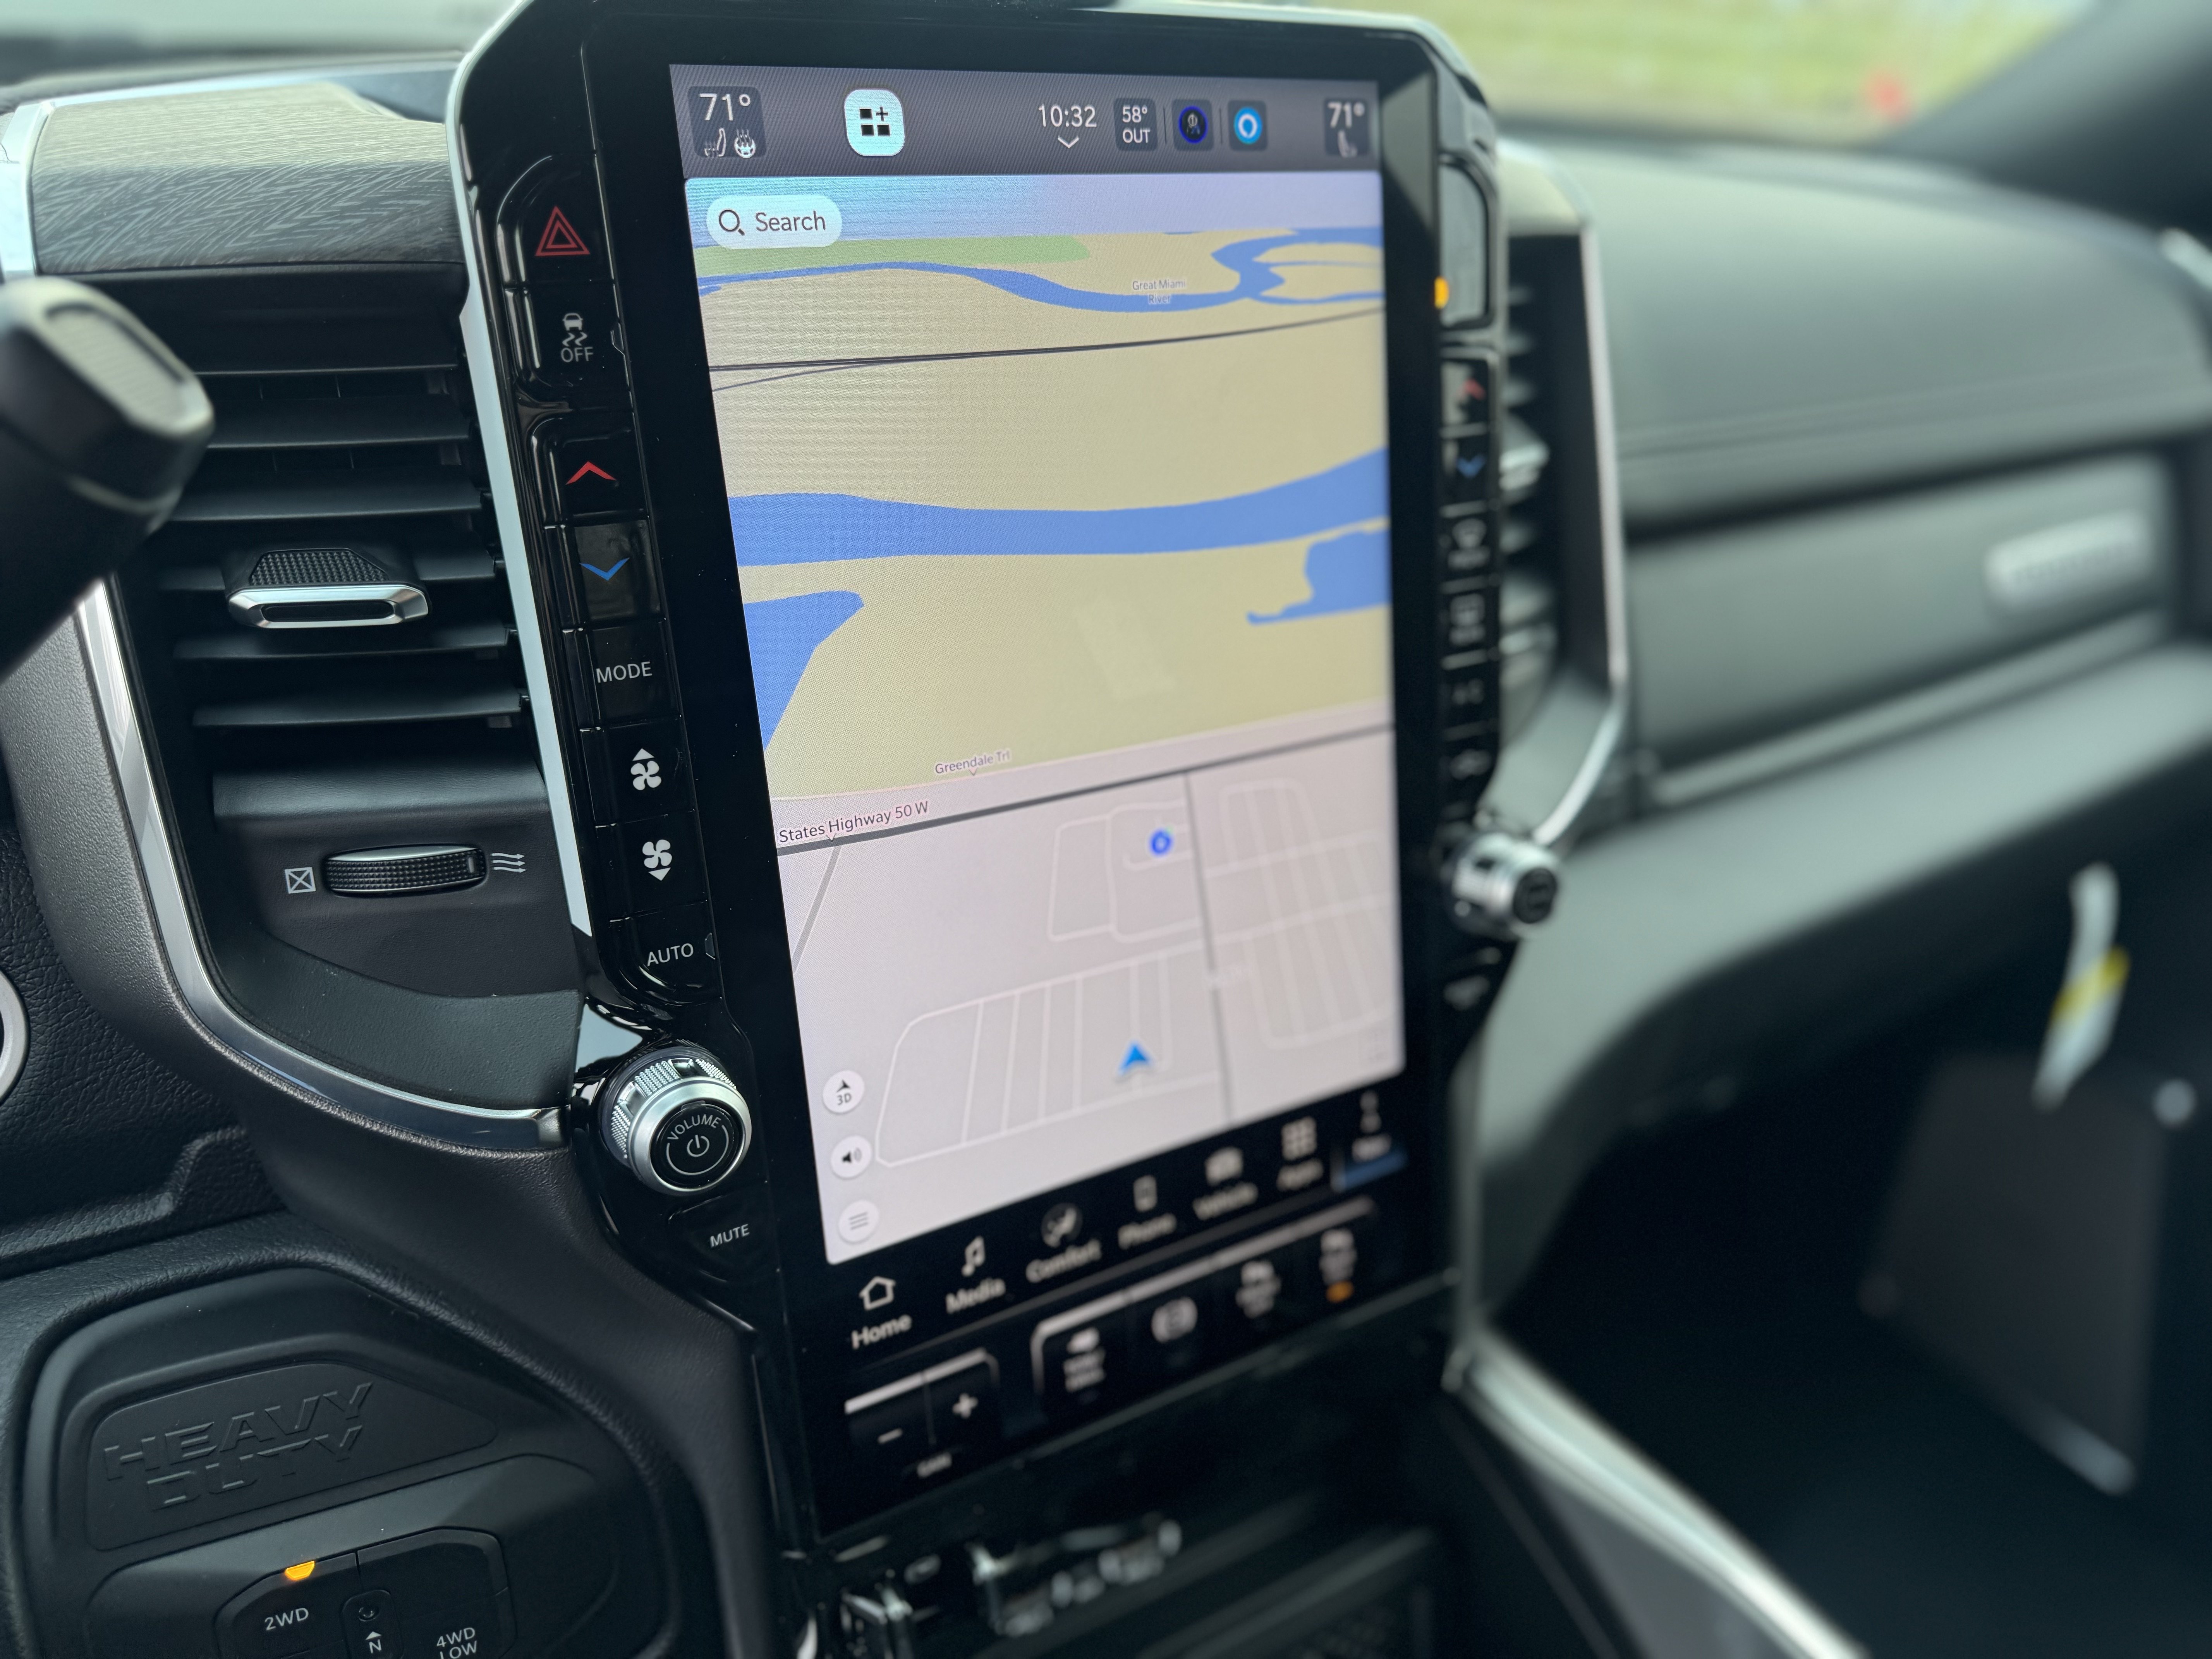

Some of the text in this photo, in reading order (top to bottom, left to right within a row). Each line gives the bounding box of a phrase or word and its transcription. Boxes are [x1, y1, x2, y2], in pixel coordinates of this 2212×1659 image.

[699, 93, 751, 122] 71°
[1039, 104, 1097, 128] 10:32
[1122, 105, 1148, 123] 58°
[1328, 102, 1365, 128] 71°
[1122, 129, 1150, 143] OUT
[755, 210, 826, 232] Search
[1132, 279, 1186, 291] Great Miami
[1148, 293, 1171, 304] River
[560, 347, 593, 362] OFF
[596, 661, 653, 684] MODE
[935, 753, 994, 774] Greendale
[779, 800, 929, 843] States Highway 50 W
[646, 943, 694, 967] AUTO
[837, 1092, 852, 1106] 3D
[667, 1114, 721, 1141] VOLUME
[710, 1224, 750, 1248] MUTE
[852, 1315, 912, 1350] Home
[946, 1278, 1006, 1314] Media
[104, 1382, 374, 1481] HEAVY
[146, 1425, 363, 1511] DUTY
[264, 1607, 309, 1630] 2WD
[369, 1639, 382, 1654] N
[436, 1627, 476, 1648] 4WD
[440, 1640, 477, 1659] LOW
